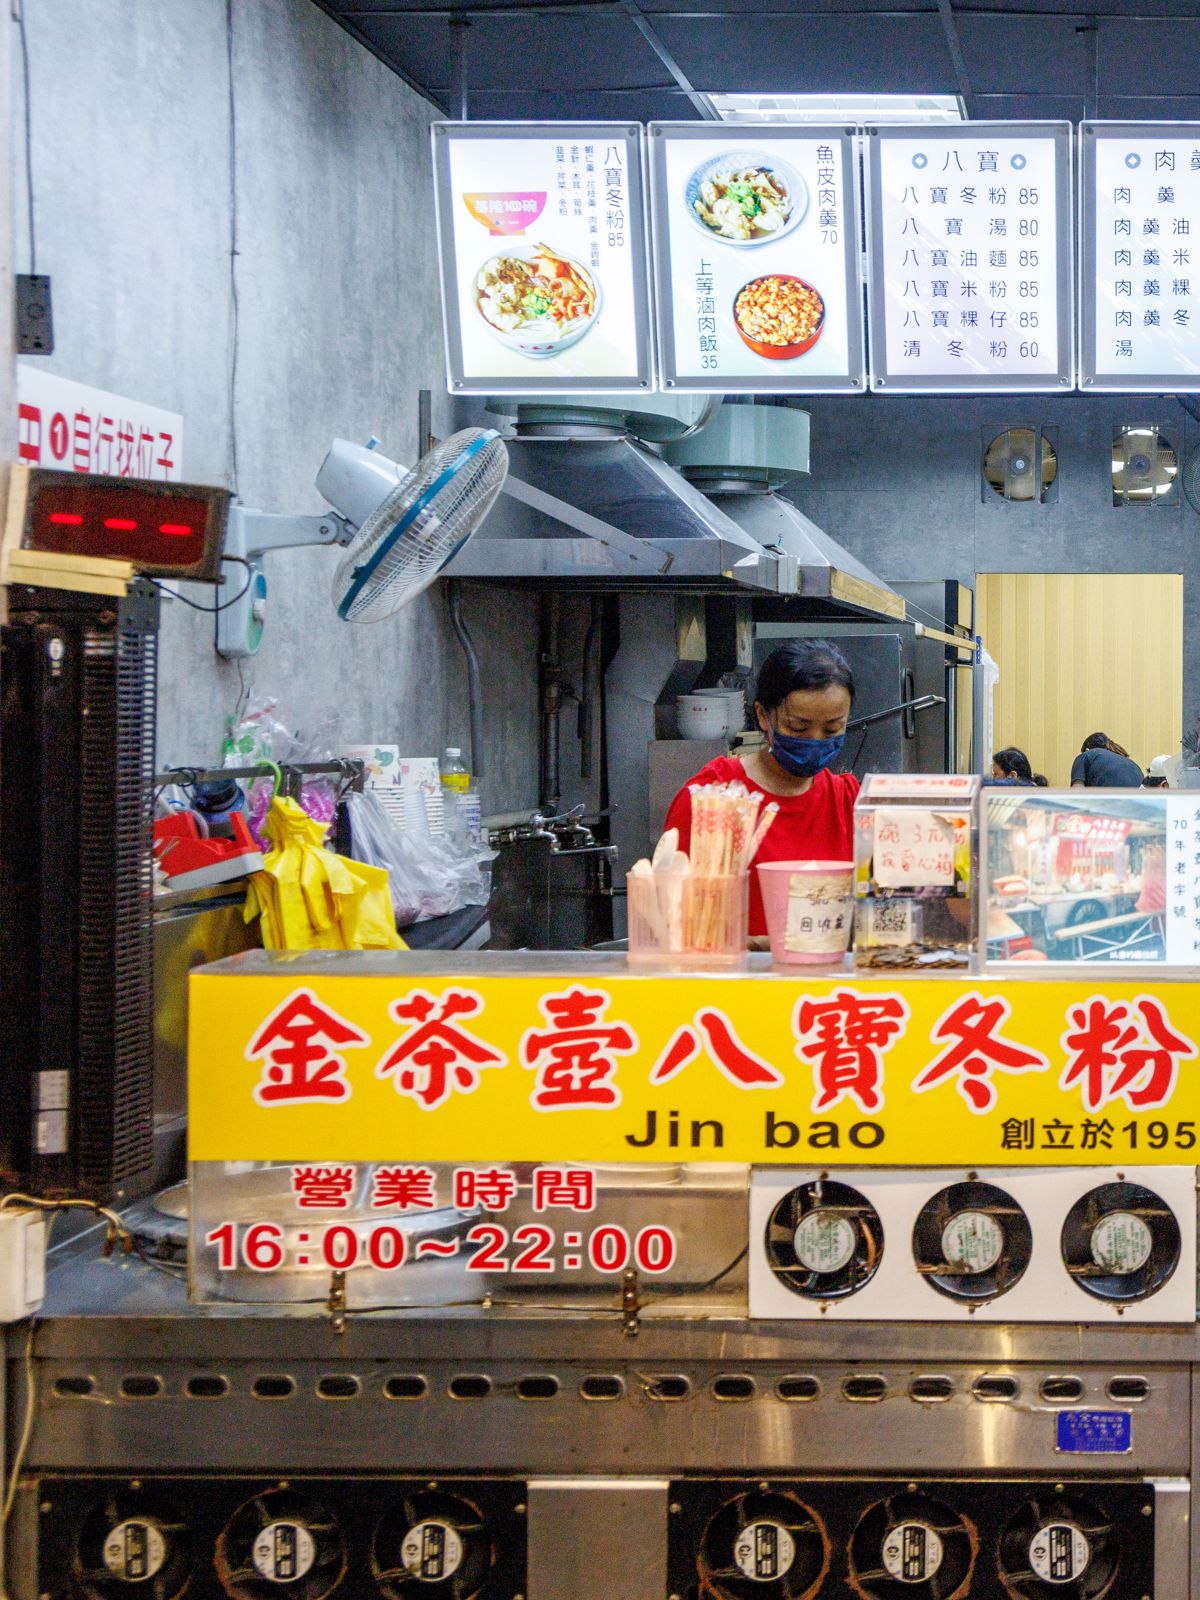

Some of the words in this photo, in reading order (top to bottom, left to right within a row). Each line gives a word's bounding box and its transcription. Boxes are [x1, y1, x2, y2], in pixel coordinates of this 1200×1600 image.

[943, 151, 999, 172] 八寶
[604, 143, 628, 228] 八寶冬粉
[816, 145, 837, 227] 魚皮肉羹
[902, 187, 1006, 204] 八寶冬粉
[1019, 188, 1038, 205] 85
[902, 218, 1006, 236] 八寶湯
[1019, 220, 1038, 236] 80
[608, 233, 624, 246] 85
[821, 231, 837, 244] 70
[902, 249, 1006, 267] 八寶油麵
[1019, 251, 1038, 266] 85
[903, 280, 1006, 297] 八寶米粉
[1020, 281, 1038, 297] 85
[696, 259, 717, 351] 上等滷肉飯
[904, 311, 1007, 328] 八寶粿仔
[1020, 312, 1038, 327] 85
[904, 340, 1007, 357] 清冬粉
[1020, 342, 1038, 357] 60
[702, 355, 717, 369] 35
[252, 992, 1192, 1108] 金茶壺八寶冬粉
[625, 1111, 723, 1147] Jin
[765, 1108, 885, 1149] bao
[293, 1166, 594, 1212] 營業時間
[205, 1223, 676, 1275] 16:00~22:00
